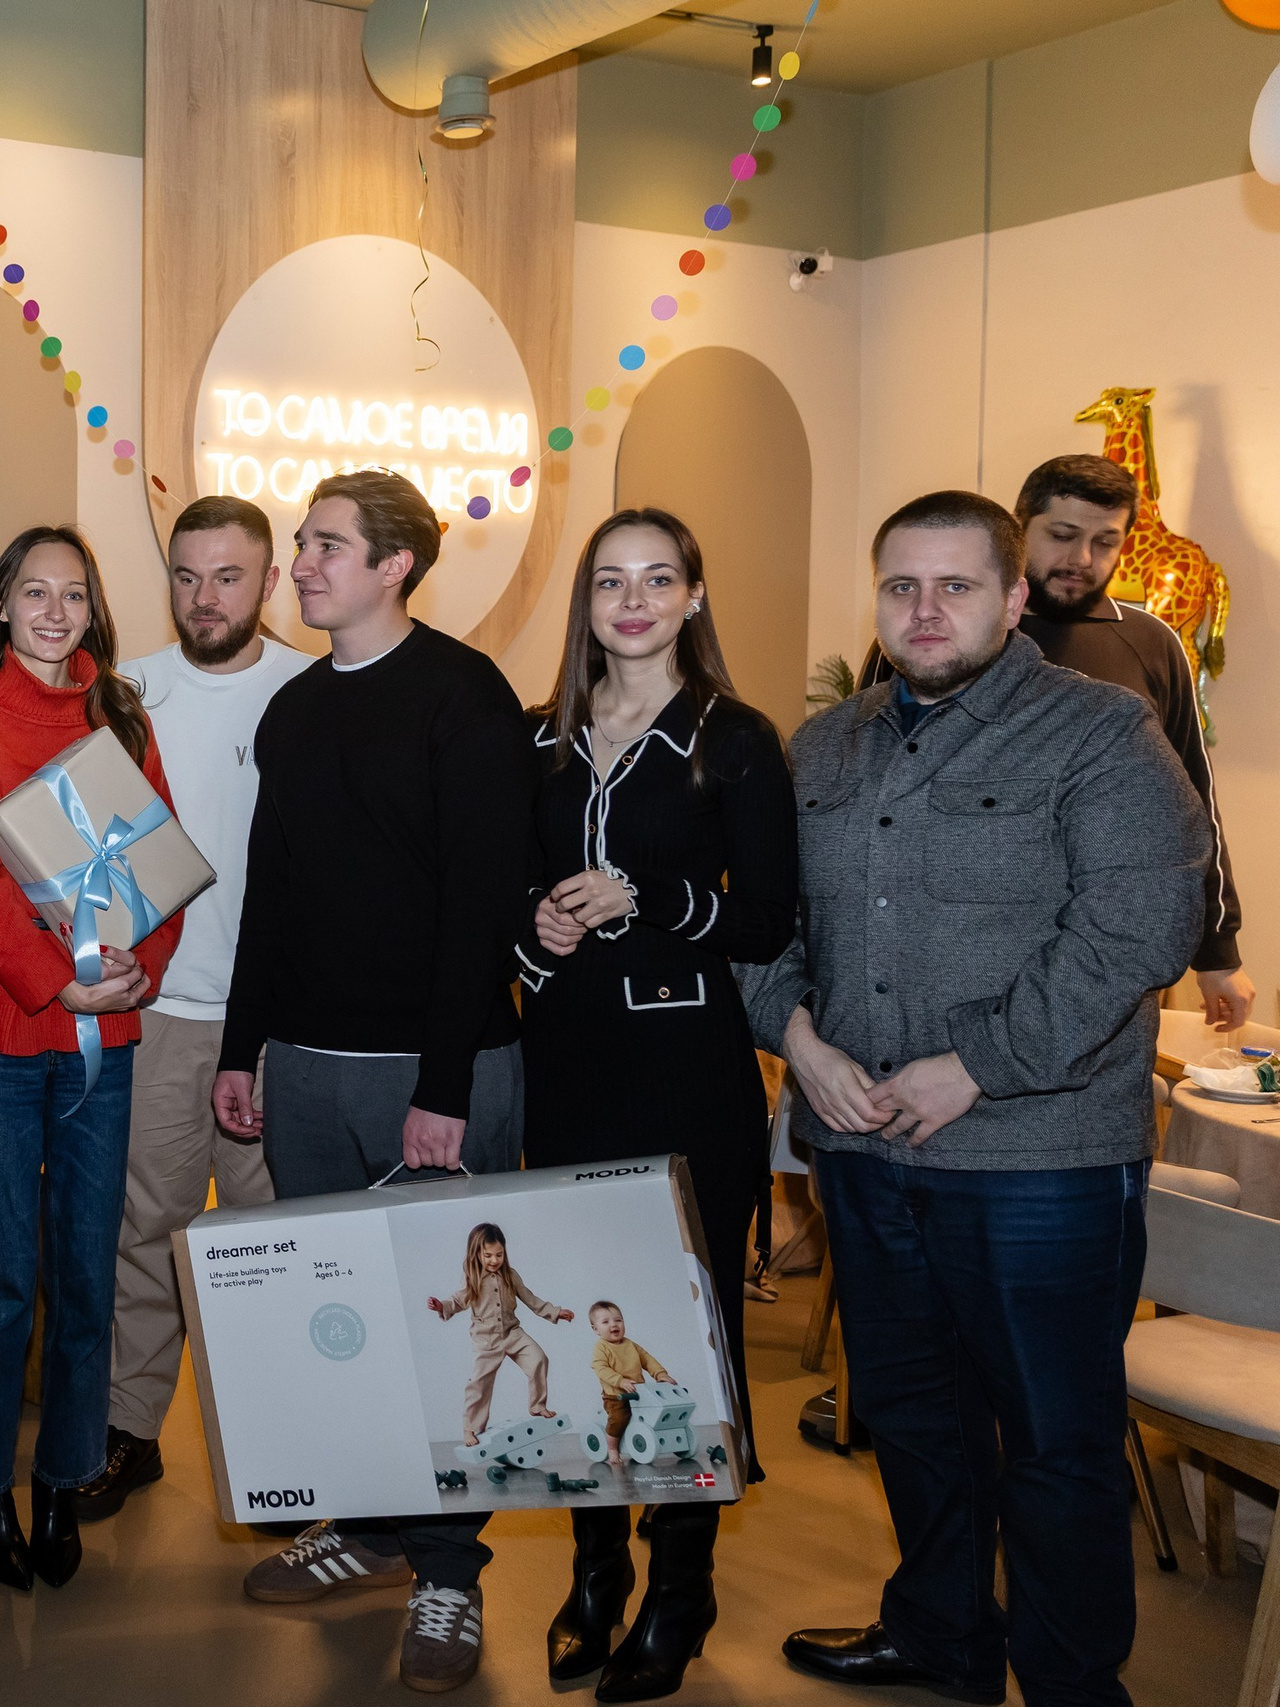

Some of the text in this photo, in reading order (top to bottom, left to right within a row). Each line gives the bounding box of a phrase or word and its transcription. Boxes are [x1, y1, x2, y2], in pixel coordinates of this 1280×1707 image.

[212, 388, 528, 456] ТО САМОЕ ВРЕМЯ
[205, 452, 265, 500] ТО
[206, 1240, 297, 1260] dreamer set
[240, 1268, 269, 1276] building
[325, 1261, 337, 1269] pcs
[224, 1279, 246, 1287] active
[315, 1272, 333, 1280] Ages
[247, 1488, 315, 1509] MODU
